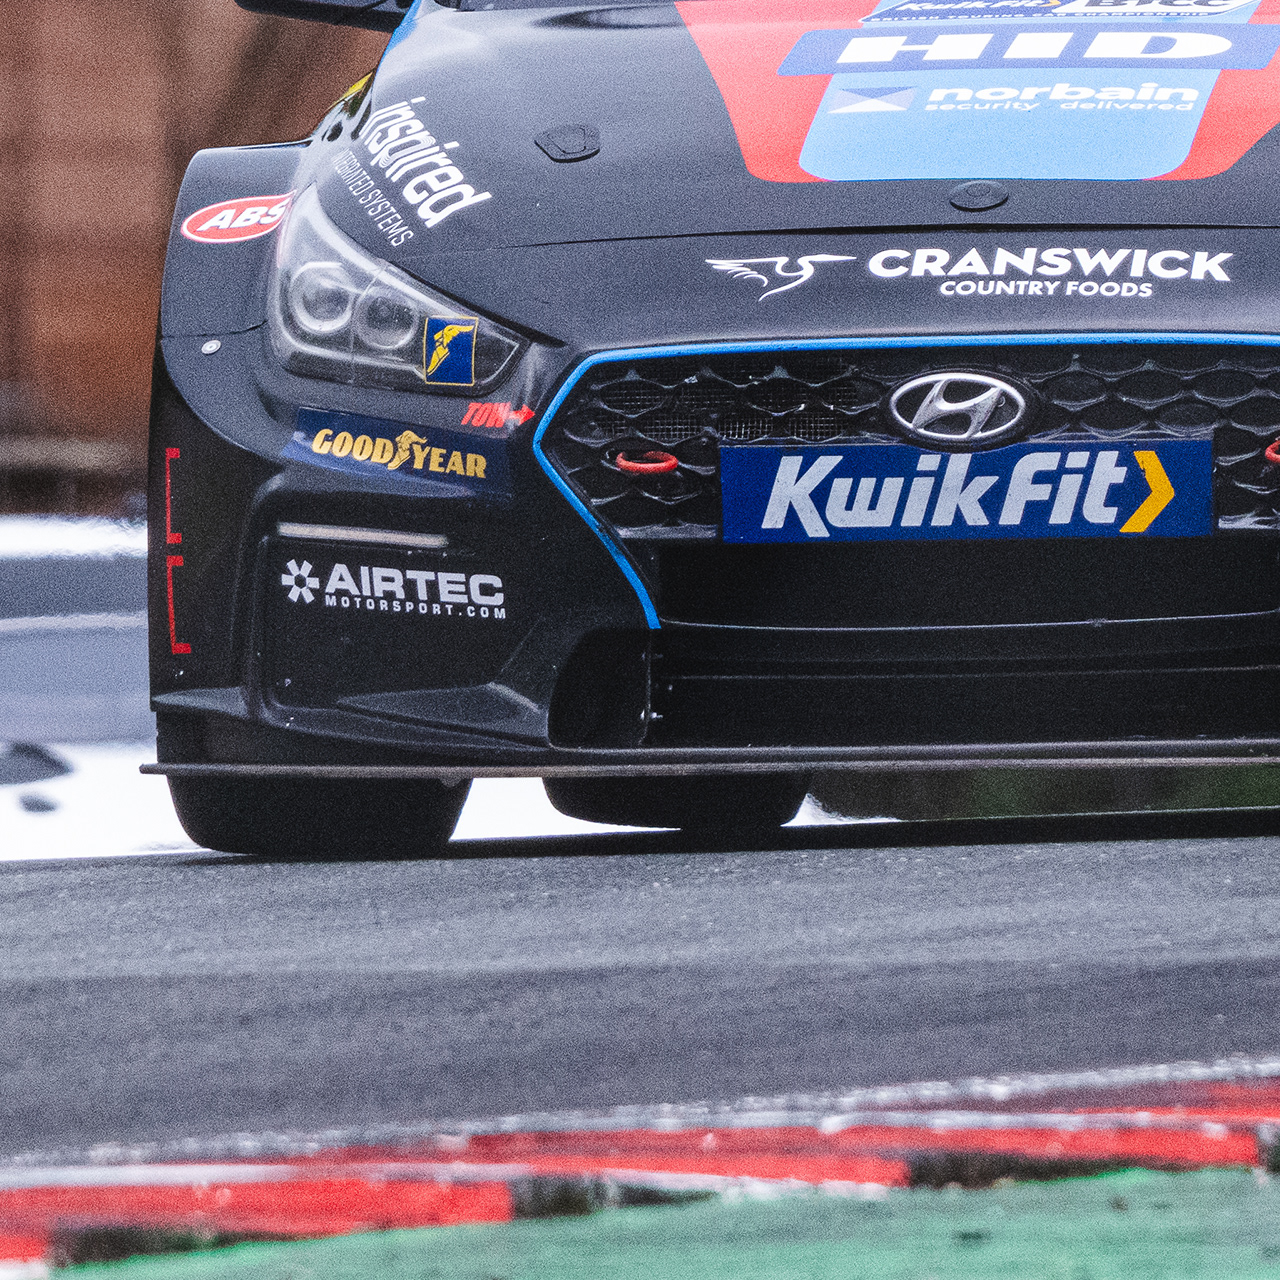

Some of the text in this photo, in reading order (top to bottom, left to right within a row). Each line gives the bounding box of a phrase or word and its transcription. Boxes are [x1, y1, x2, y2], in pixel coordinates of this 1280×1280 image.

[835, 31, 1233, 64] HID
[924, 99, 1195, 113] security delivered
[928, 82, 1200, 103] norbain
[358, 96, 493, 229] inspired
[196, 198, 292, 232] ABS
[358, 188, 414, 247] SYSTEMS
[868, 247, 1234, 282] CRANSWICK
[939, 280, 1153, 297] COUNTRY FOODS
[460, 401, 511, 428] TOW
[312, 430, 487, 479] GOODYEAR
[324, 562, 505, 604] AIRTEC
[324, 594, 507, 619] MOTORSPORT.COM
